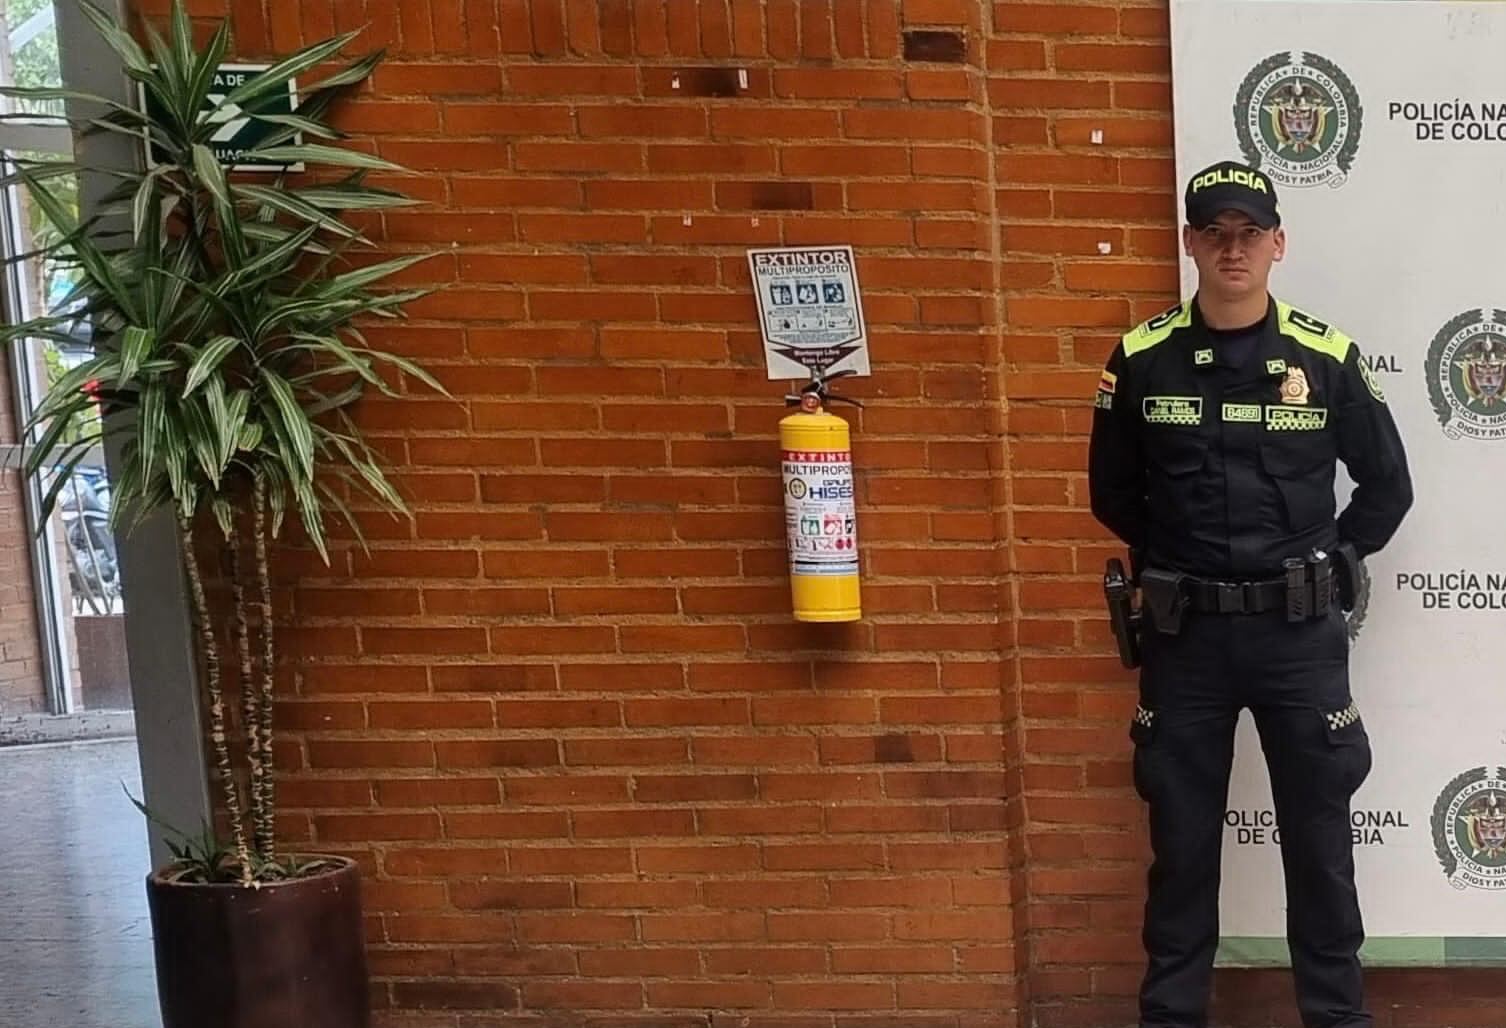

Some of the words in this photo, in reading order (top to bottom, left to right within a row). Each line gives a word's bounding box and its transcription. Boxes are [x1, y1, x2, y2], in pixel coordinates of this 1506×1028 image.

[227, 75, 245, 86] DE
[1292, 67, 1305, 75] DE
[1316, 74, 1346, 128] COLOMBIA
[1389, 98, 1475, 121] POLICÍA
[1416, 122, 1444, 141] DE
[1300, 140, 1342, 170] NACIONAL
[755, 251, 847, 265] EXTINTOR
[1482, 324, 1496, 332] DE
[1397, 569, 1480, 591] POLICÍA
[1423, 593, 1450, 609] DE
[1224, 810, 1273, 827] OLIC
[1351, 811, 1409, 827] ONAL
[1238, 829, 1265, 844] DE
